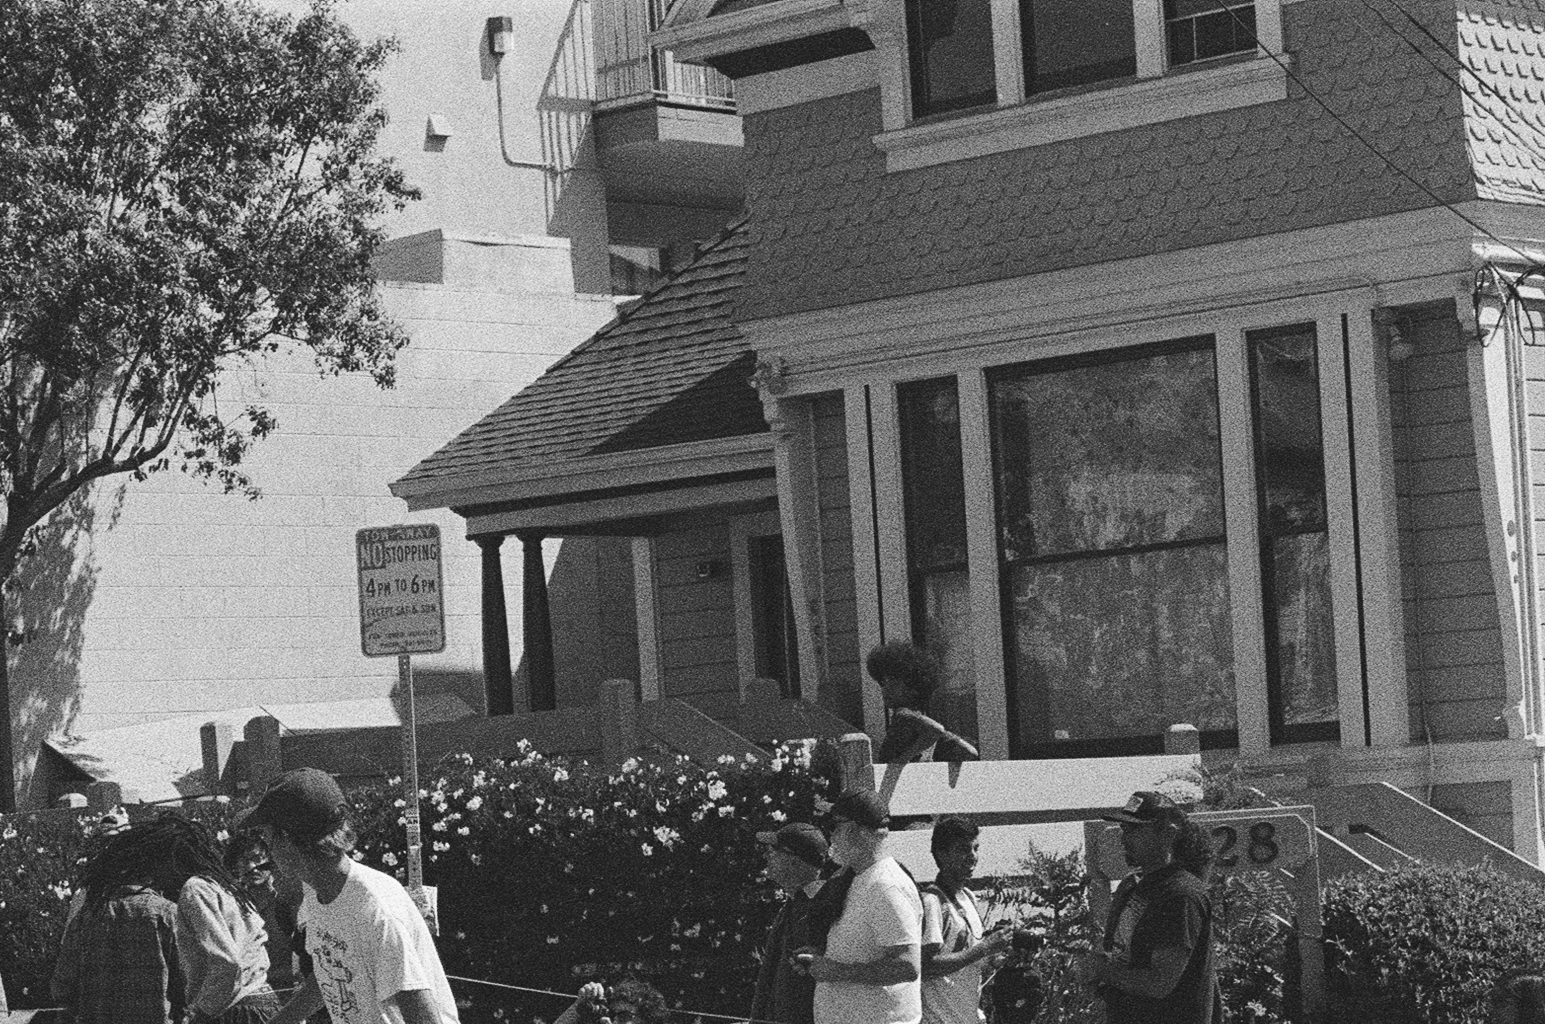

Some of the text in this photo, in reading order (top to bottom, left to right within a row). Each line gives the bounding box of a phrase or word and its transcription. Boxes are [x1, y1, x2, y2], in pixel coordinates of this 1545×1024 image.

[361, 543, 437, 567] NO STOPPING
[395, 579, 407, 592] TO
[367, 606, 394, 618] EXCEPT
